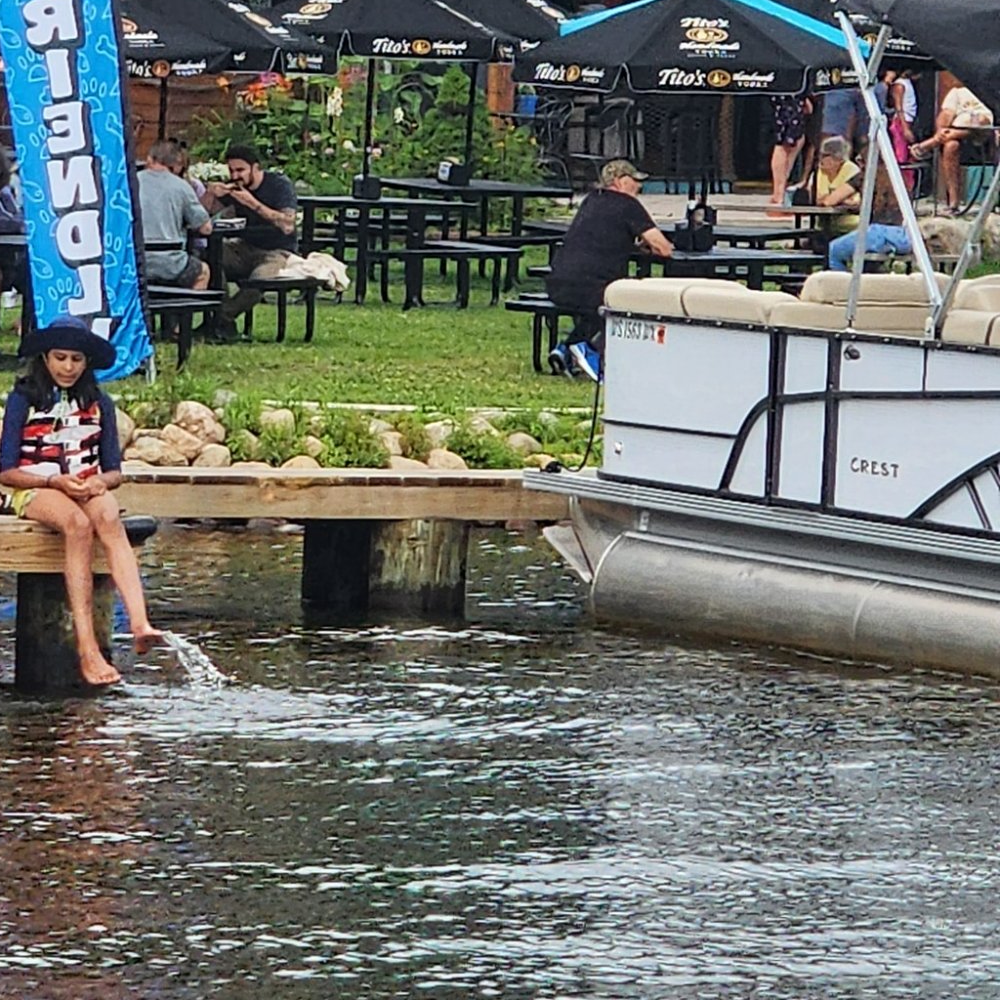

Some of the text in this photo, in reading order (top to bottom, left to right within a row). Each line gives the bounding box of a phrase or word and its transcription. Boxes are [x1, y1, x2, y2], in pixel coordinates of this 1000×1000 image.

[372, 36, 412, 54] Tito's
[658, 66, 706, 87] Tito's
[850, 457, 900, 478] CREST
